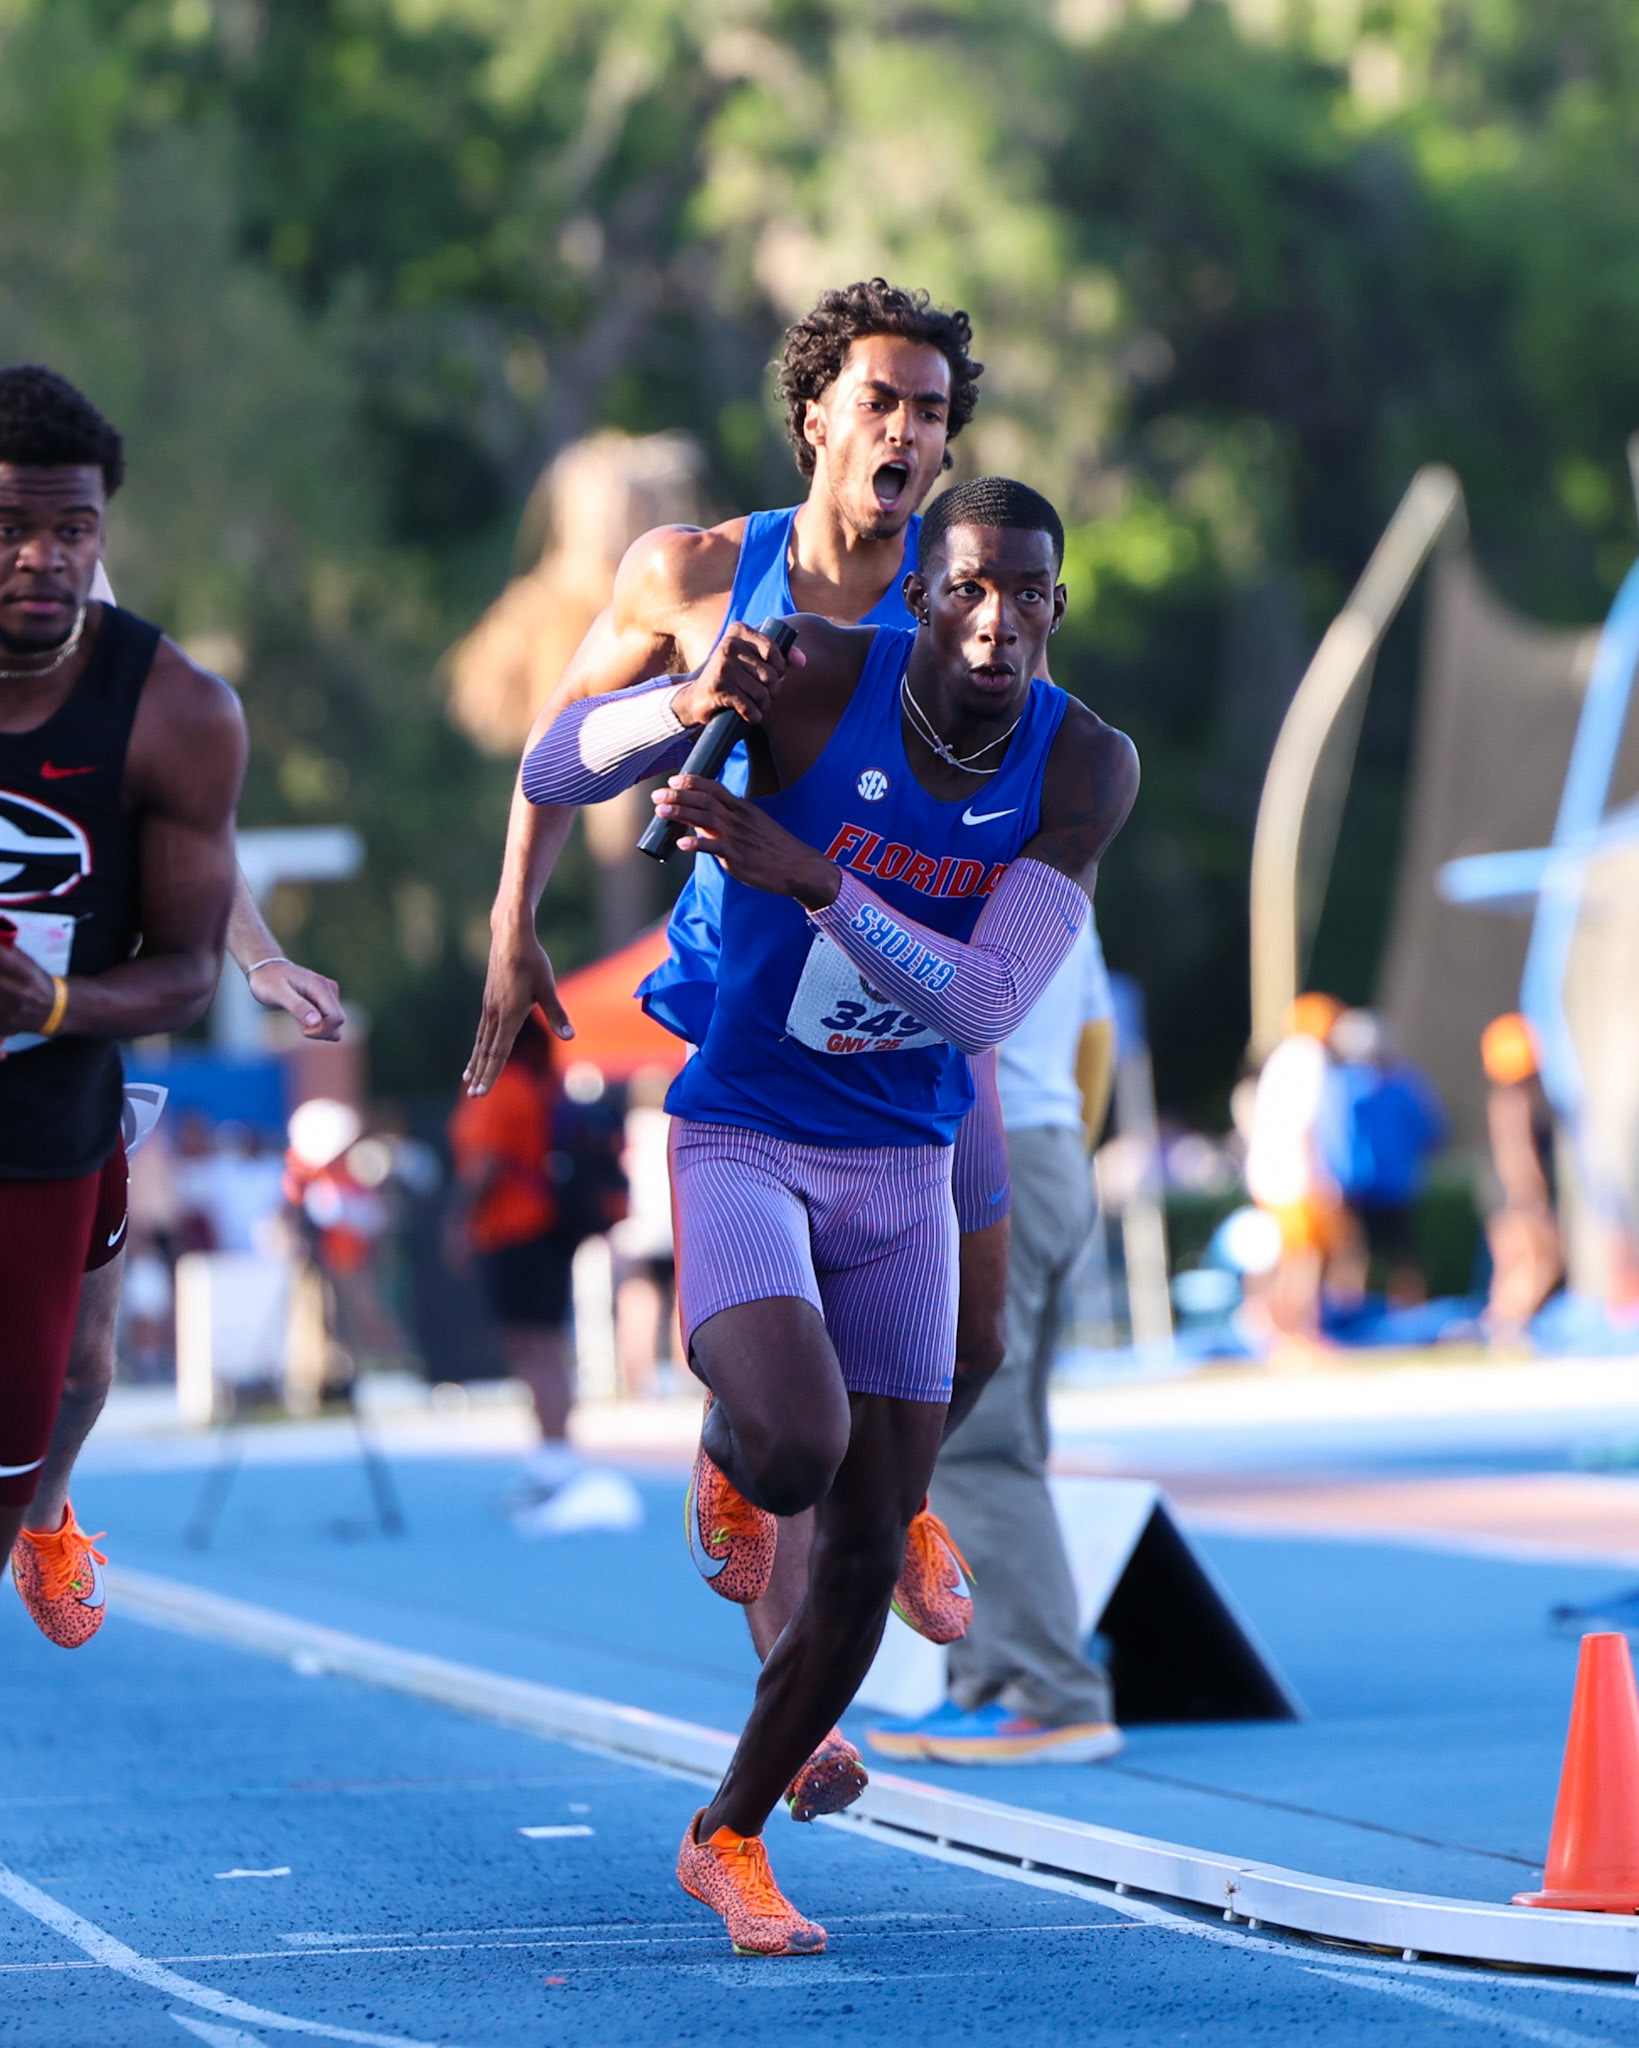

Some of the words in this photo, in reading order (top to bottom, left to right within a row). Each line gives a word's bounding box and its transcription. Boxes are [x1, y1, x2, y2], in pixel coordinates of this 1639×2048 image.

[857, 769, 888, 801] SEC
[823, 822, 1009, 898] FLORIDA
[849, 904, 957, 993] GATORS
[826, 1033, 874, 1053] GNV
